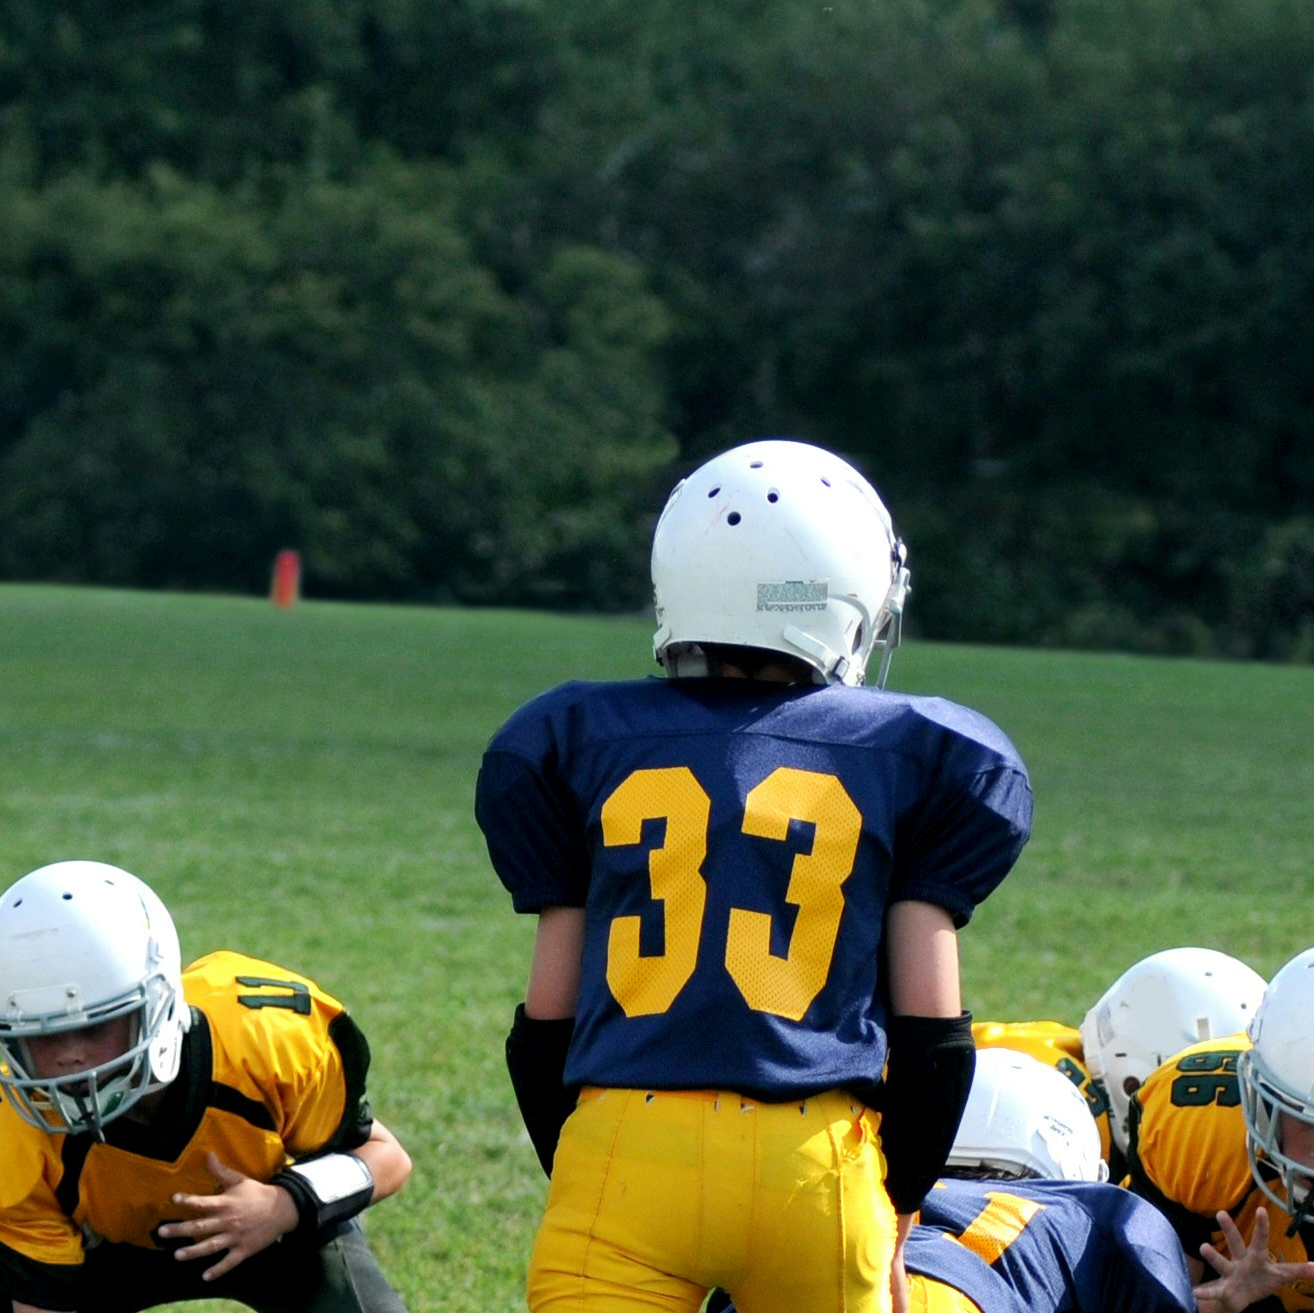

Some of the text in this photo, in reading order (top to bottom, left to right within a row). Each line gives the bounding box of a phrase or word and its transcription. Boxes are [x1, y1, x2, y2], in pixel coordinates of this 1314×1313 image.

[601, 766, 863, 1021] 33
[235, 976, 312, 1015] 11
[1170, 1051, 1242, 1108] 66
